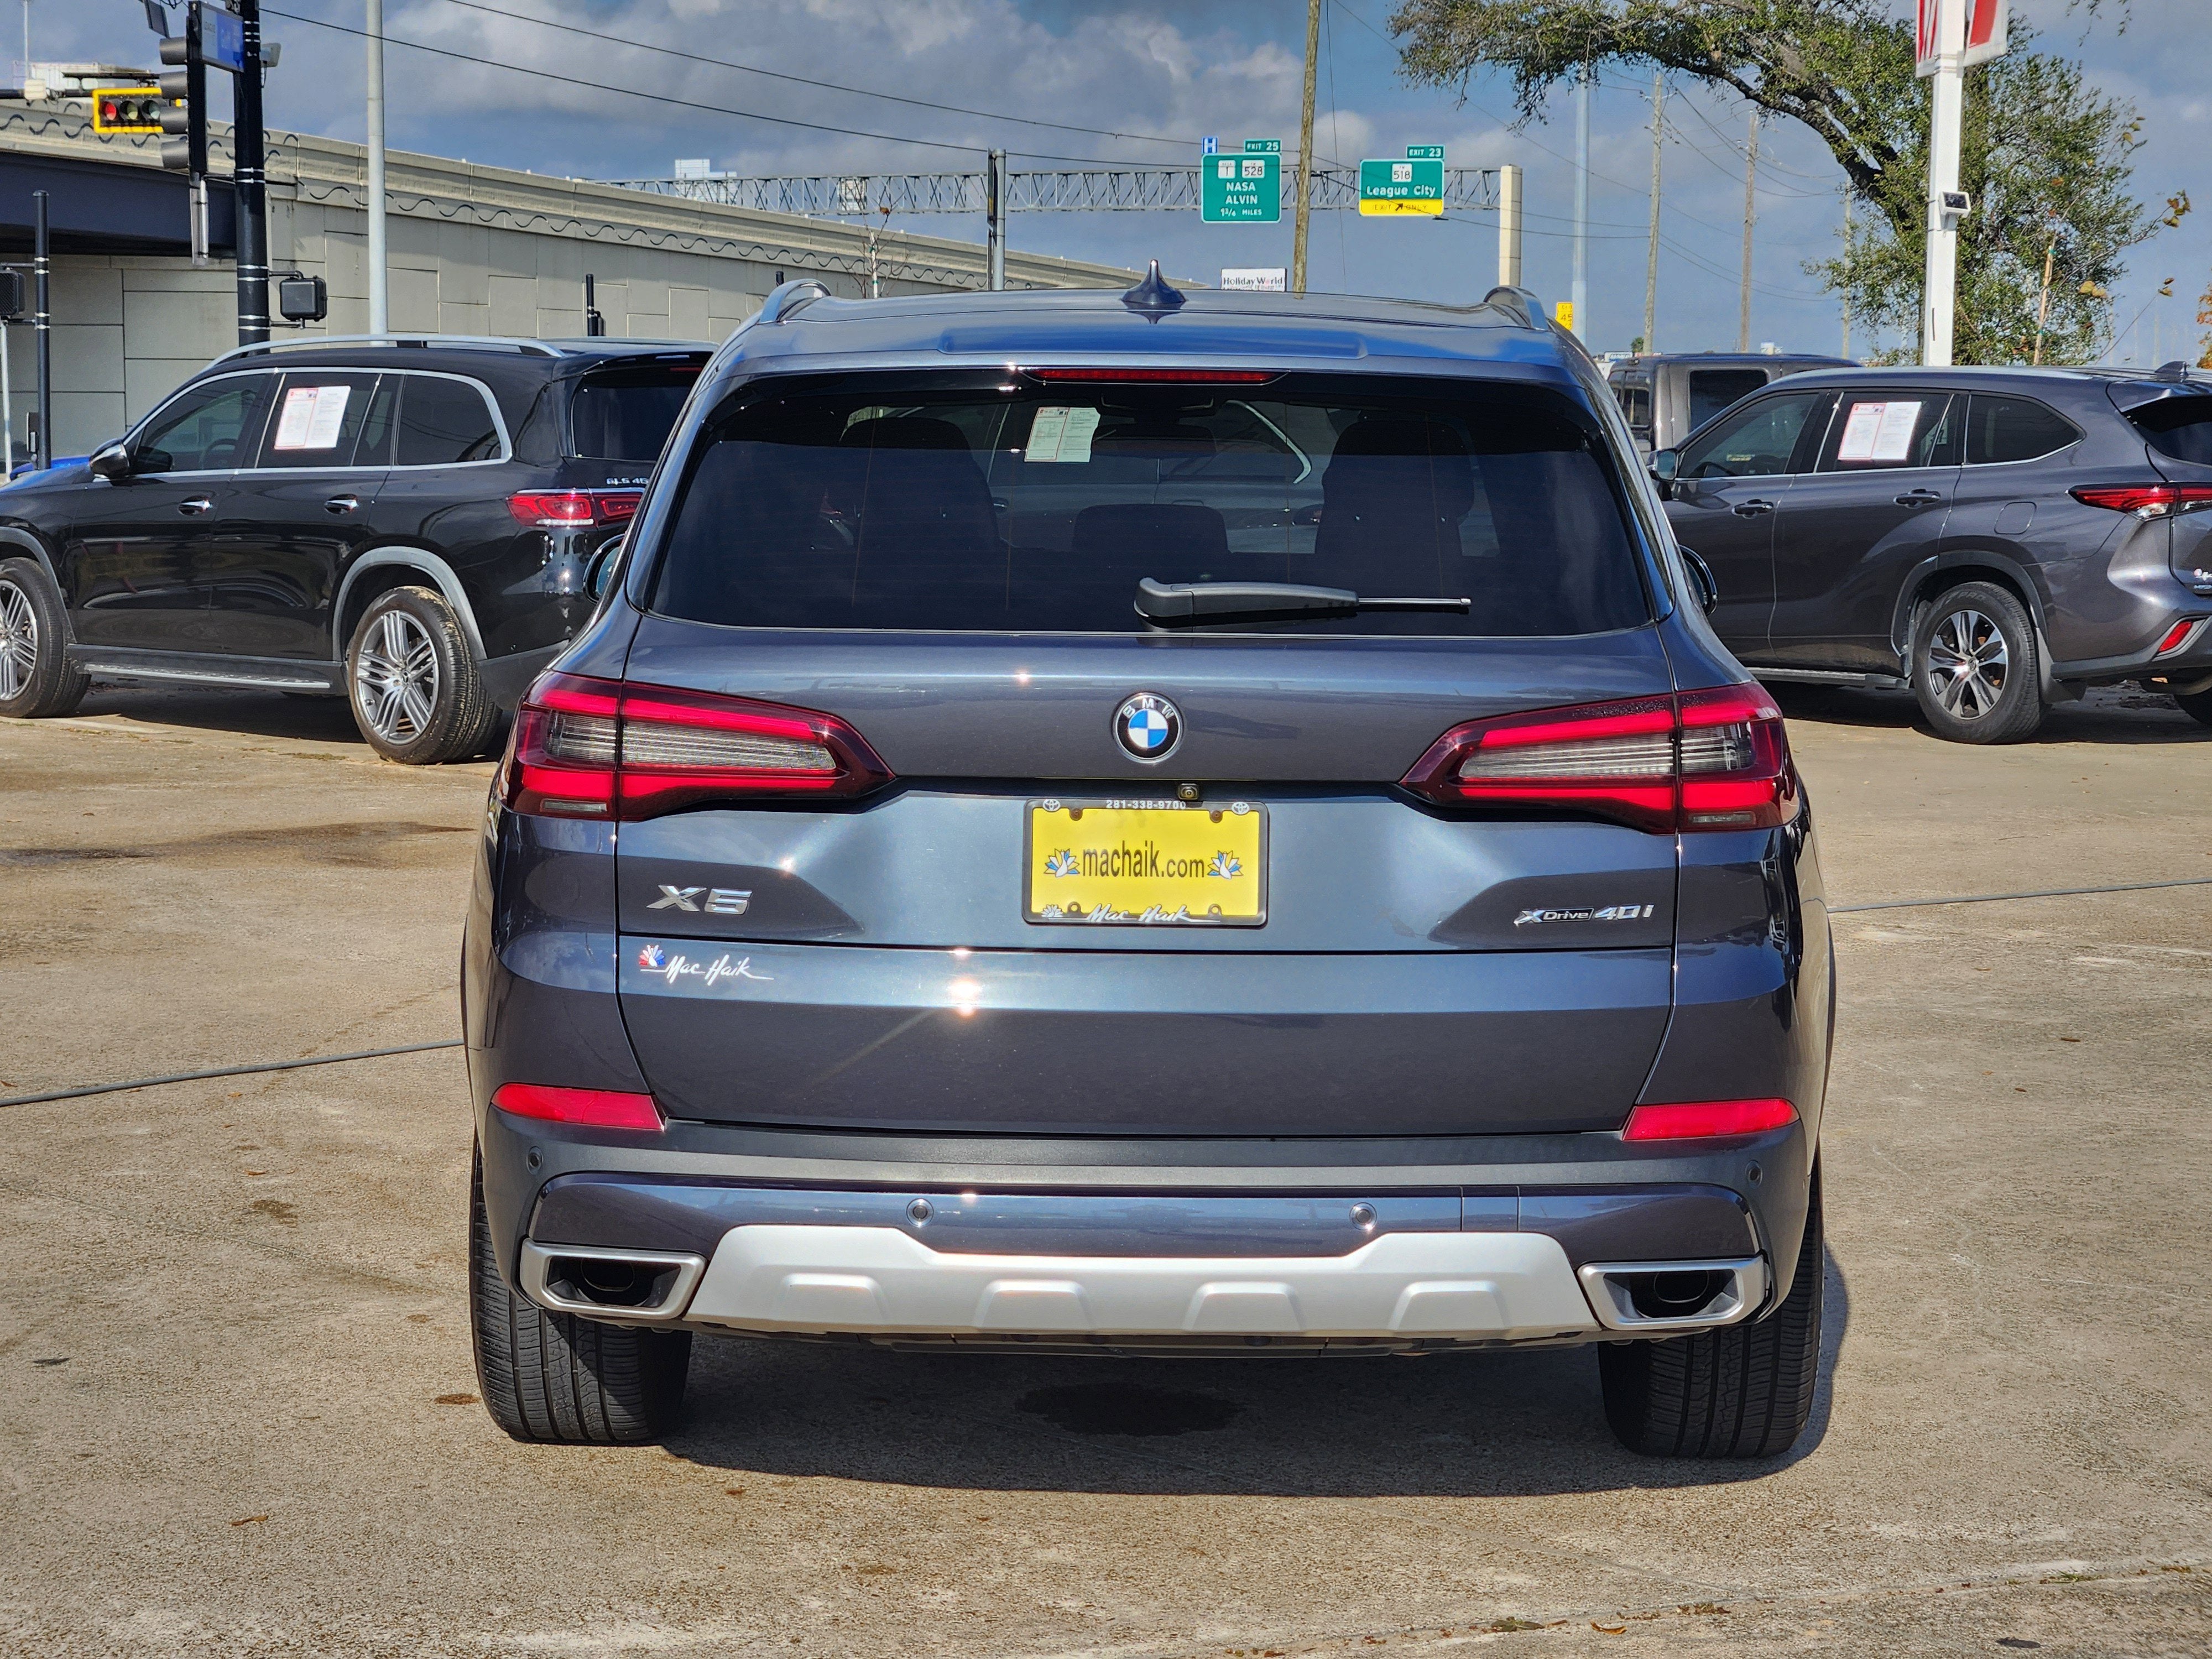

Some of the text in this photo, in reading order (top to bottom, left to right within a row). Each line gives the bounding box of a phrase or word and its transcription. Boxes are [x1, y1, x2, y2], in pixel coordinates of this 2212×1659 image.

[1204, 138, 1217, 153] H
[1266, 142, 1279, 151] 25
[1429, 148, 1442, 157] 23
[1244, 166, 1262, 176] 528
[1394, 170, 1410, 180] 518
[1226, 181, 1256, 191] NASA
[1366, 185, 1436, 198] League City
[1225, 195, 1258, 205] ALVIN
[1223, 276, 1255, 287] Holiday
[1122, 698, 1175, 719] BMW
[1106, 800, 1186, 810] 281-338-9700
[1082, 839, 1204, 878] machaik.com
[646, 885, 753, 915] X5
[1085, 903, 1134, 922] Mac
[664, 954, 757, 986] Mac Haik
